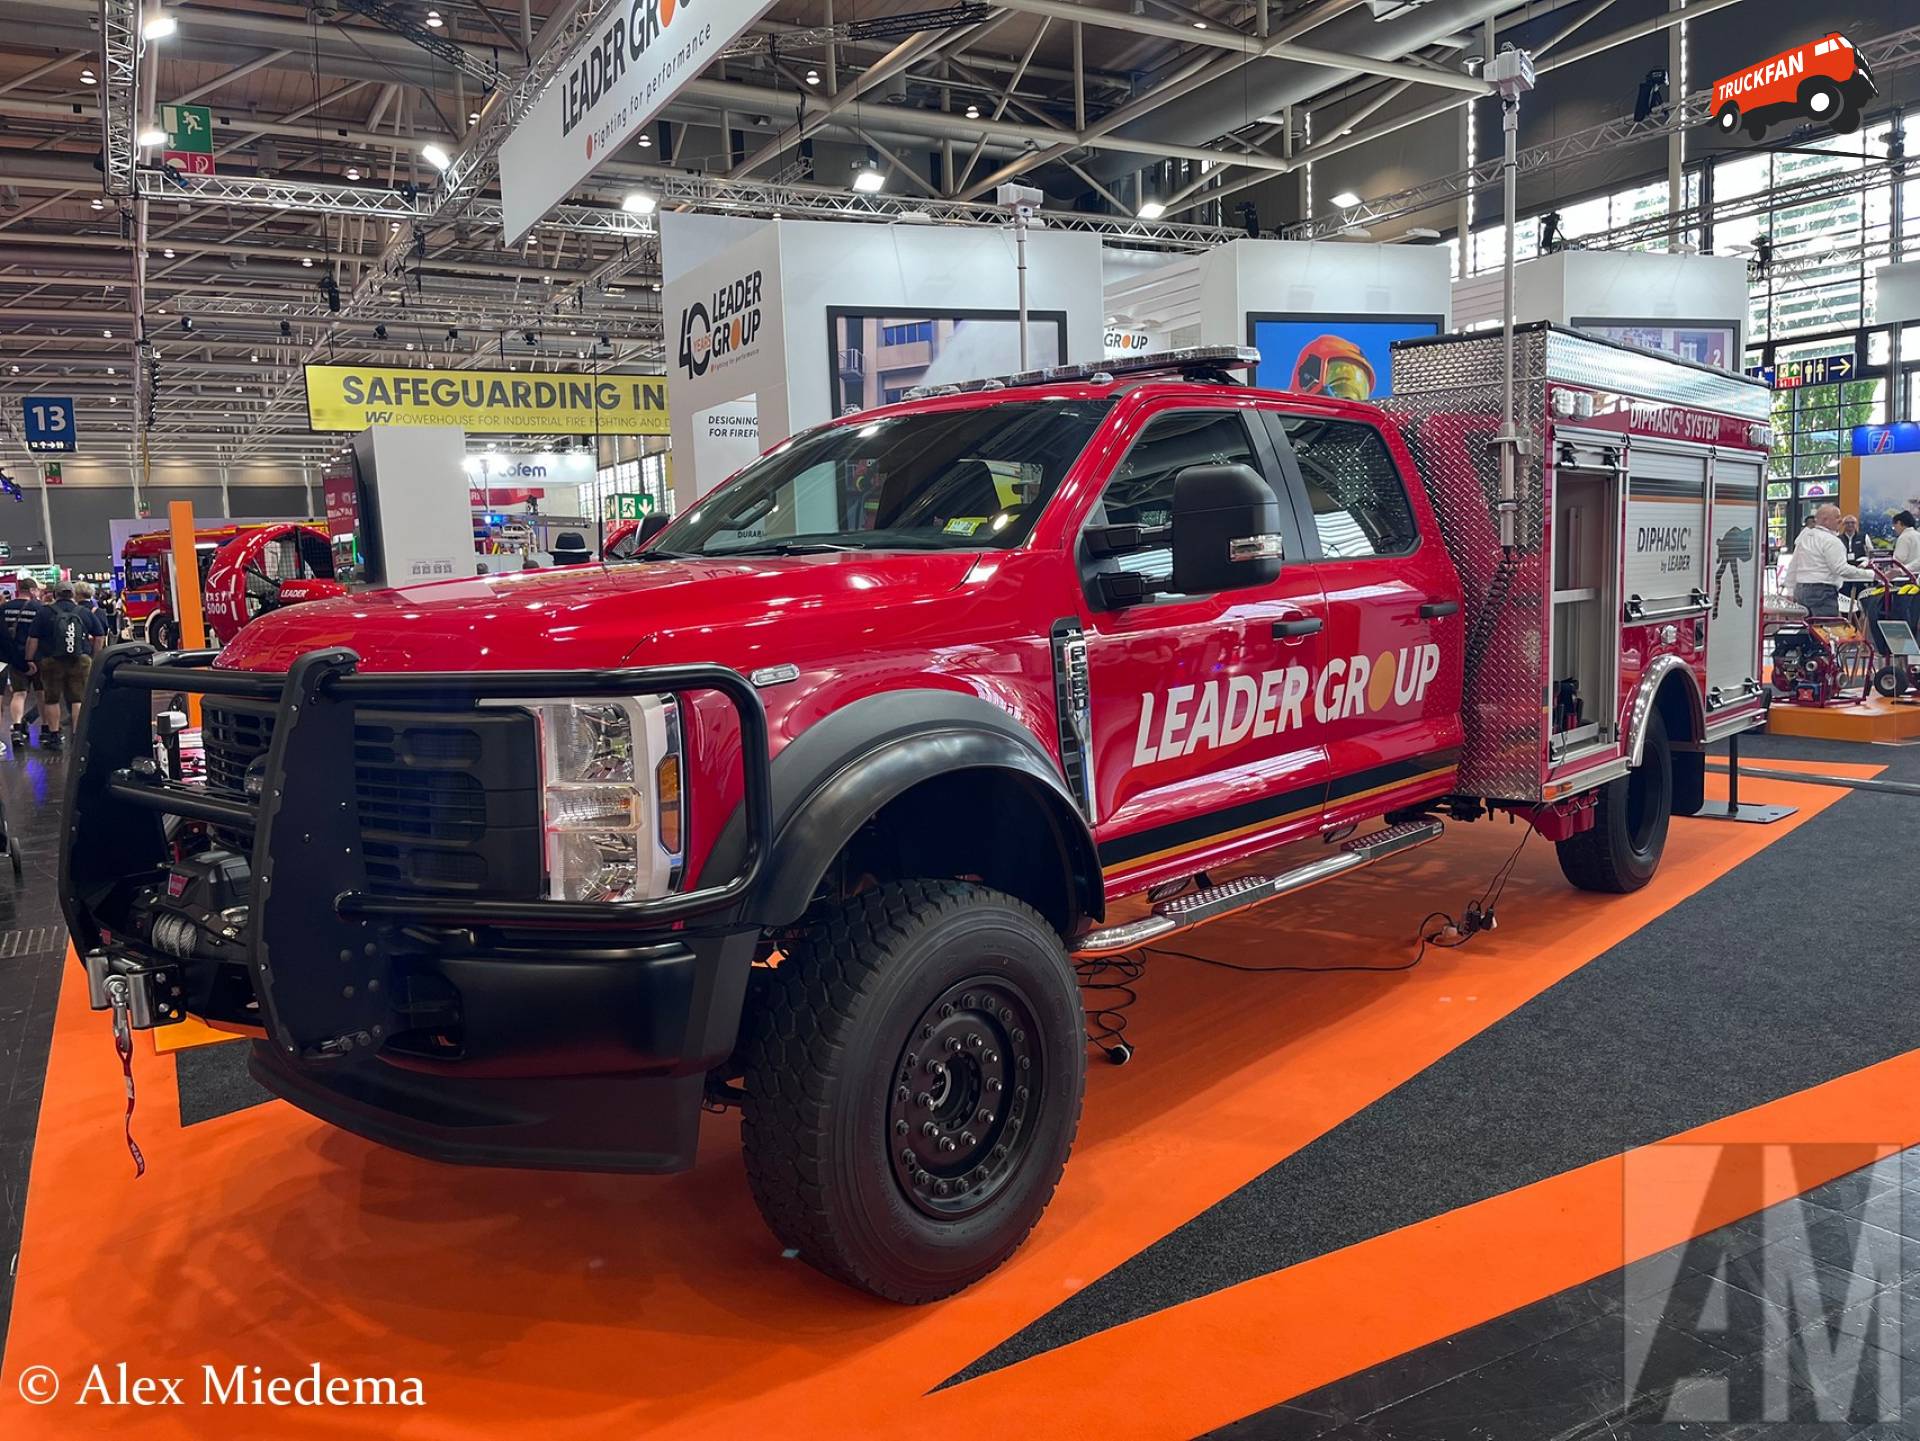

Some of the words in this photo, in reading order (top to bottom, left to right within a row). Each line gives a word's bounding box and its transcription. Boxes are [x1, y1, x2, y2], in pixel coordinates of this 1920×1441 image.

[562, 17, 626, 137] LEADER
[629, 0, 691, 62] GR
[593, 108, 627, 150] Fighting
[630, 91, 643, 114] for
[646, 23, 711, 101] performance
[712, 270, 762, 324] LEADER
[679, 302, 711, 380] 40
[712, 308, 761, 358] GROUP
[1104, 333, 1148, 350] GROUP
[1713, 348, 1721, 367] 2
[342, 375, 622, 411] SAFEGUARDING
[32, 405, 66, 431] 13
[395, 414, 475, 426] POWERHOUSE
[478, 415, 500, 426] FOR
[503, 415, 564, 427] INDUSTRIAL
[565, 417, 586, 428] FIRE
[589, 416, 638, 428] FGHTING
[640, 418, 662, 428] AND
[708, 416, 758, 425] DESIGNING
[1685, 413, 1720, 440] SYSTEM
[709, 428, 727, 437] FOR
[1668, 555, 1690, 572] LEADER
[280, 588, 307, 599] LEADER
[1132, 666, 1308, 768] LEADER
[1314, 643, 1440, 724] GROUP
